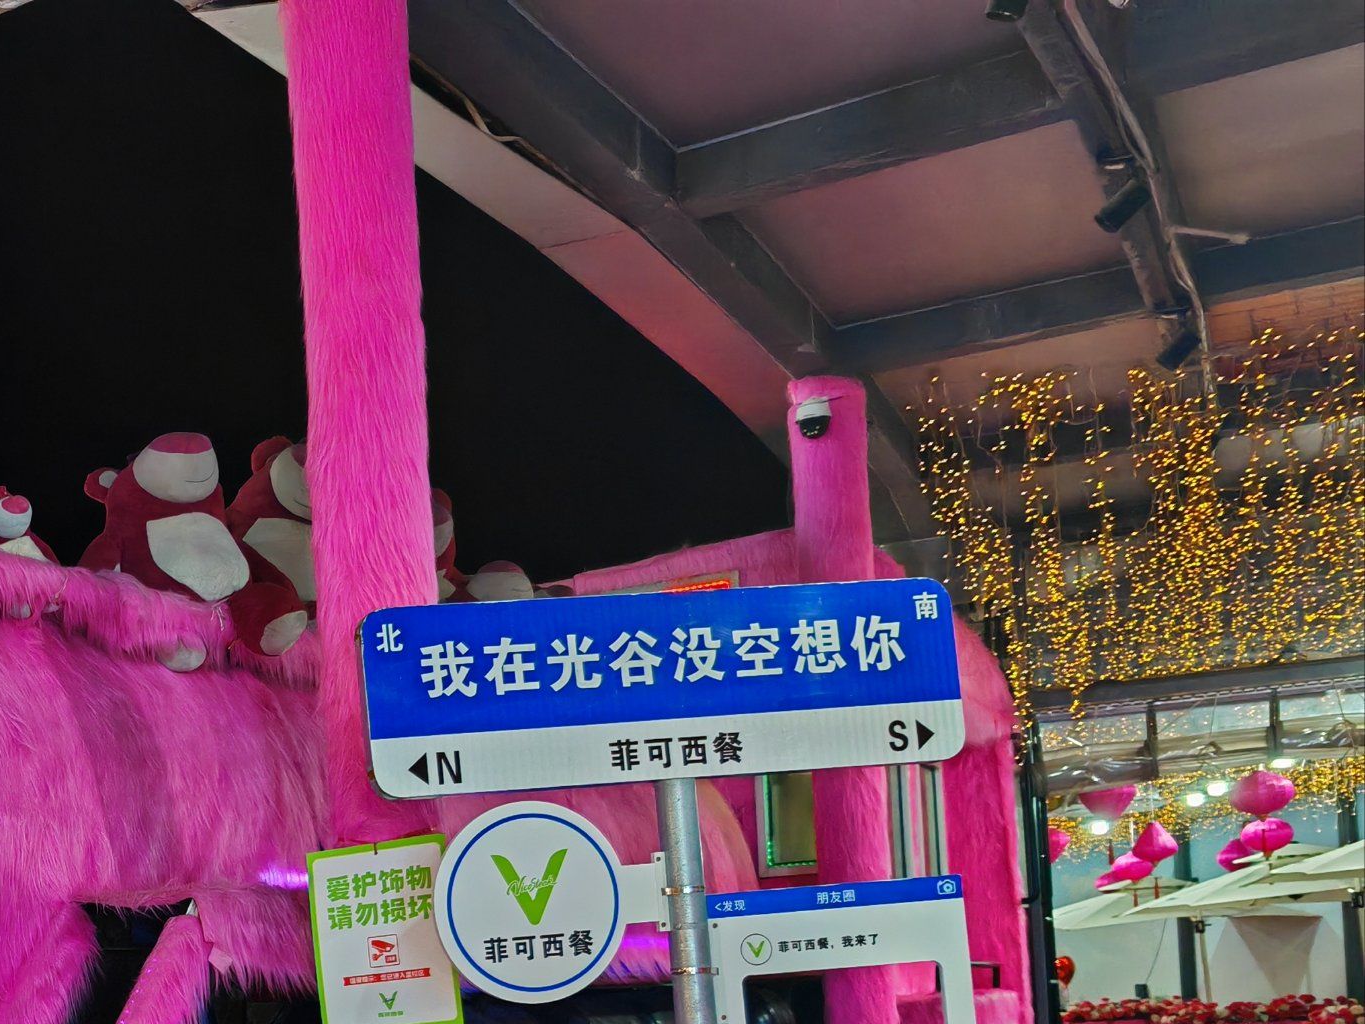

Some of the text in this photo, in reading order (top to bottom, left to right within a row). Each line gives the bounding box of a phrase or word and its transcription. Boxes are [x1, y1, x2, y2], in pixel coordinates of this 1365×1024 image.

[913, 592, 939, 620] 南
[376, 624, 404, 653] 北
[420, 615, 907, 699] 我在光谷没空想你
[609, 732, 744, 771] 菲可西餐
[888, 720, 909, 752] S
[438, 751, 462, 784] N
[326, 865, 432, 902] 爱护饰物
[816, 889, 856, 905] 朋友圈
[328, 894, 433, 930] 请勿损坏
[722, 900, 746, 912] 发现
[484, 930, 594, 963] 菲可西餐
